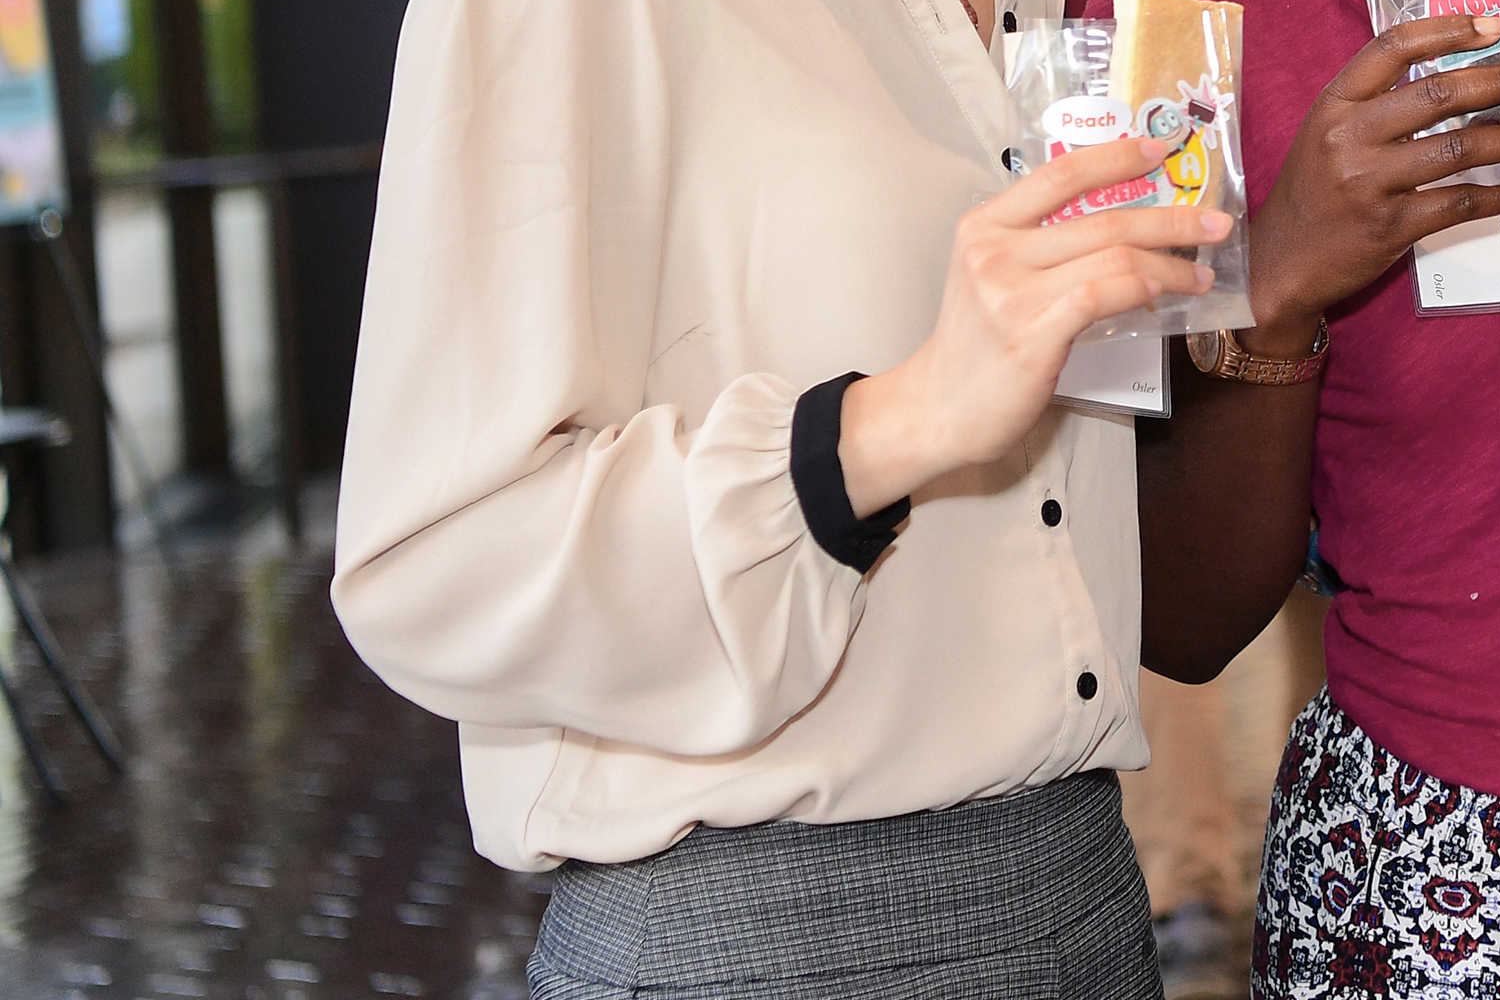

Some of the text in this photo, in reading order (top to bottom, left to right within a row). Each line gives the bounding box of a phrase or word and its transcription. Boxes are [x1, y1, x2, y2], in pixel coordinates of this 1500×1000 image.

[1062, 112, 1116, 128] Peach
[1180, 153, 1201, 180] A
[1085, 176, 1158, 208] CREAM
[1433, 273, 1445, 299] Osler
[1132, 381, 1156, 394] Osler
